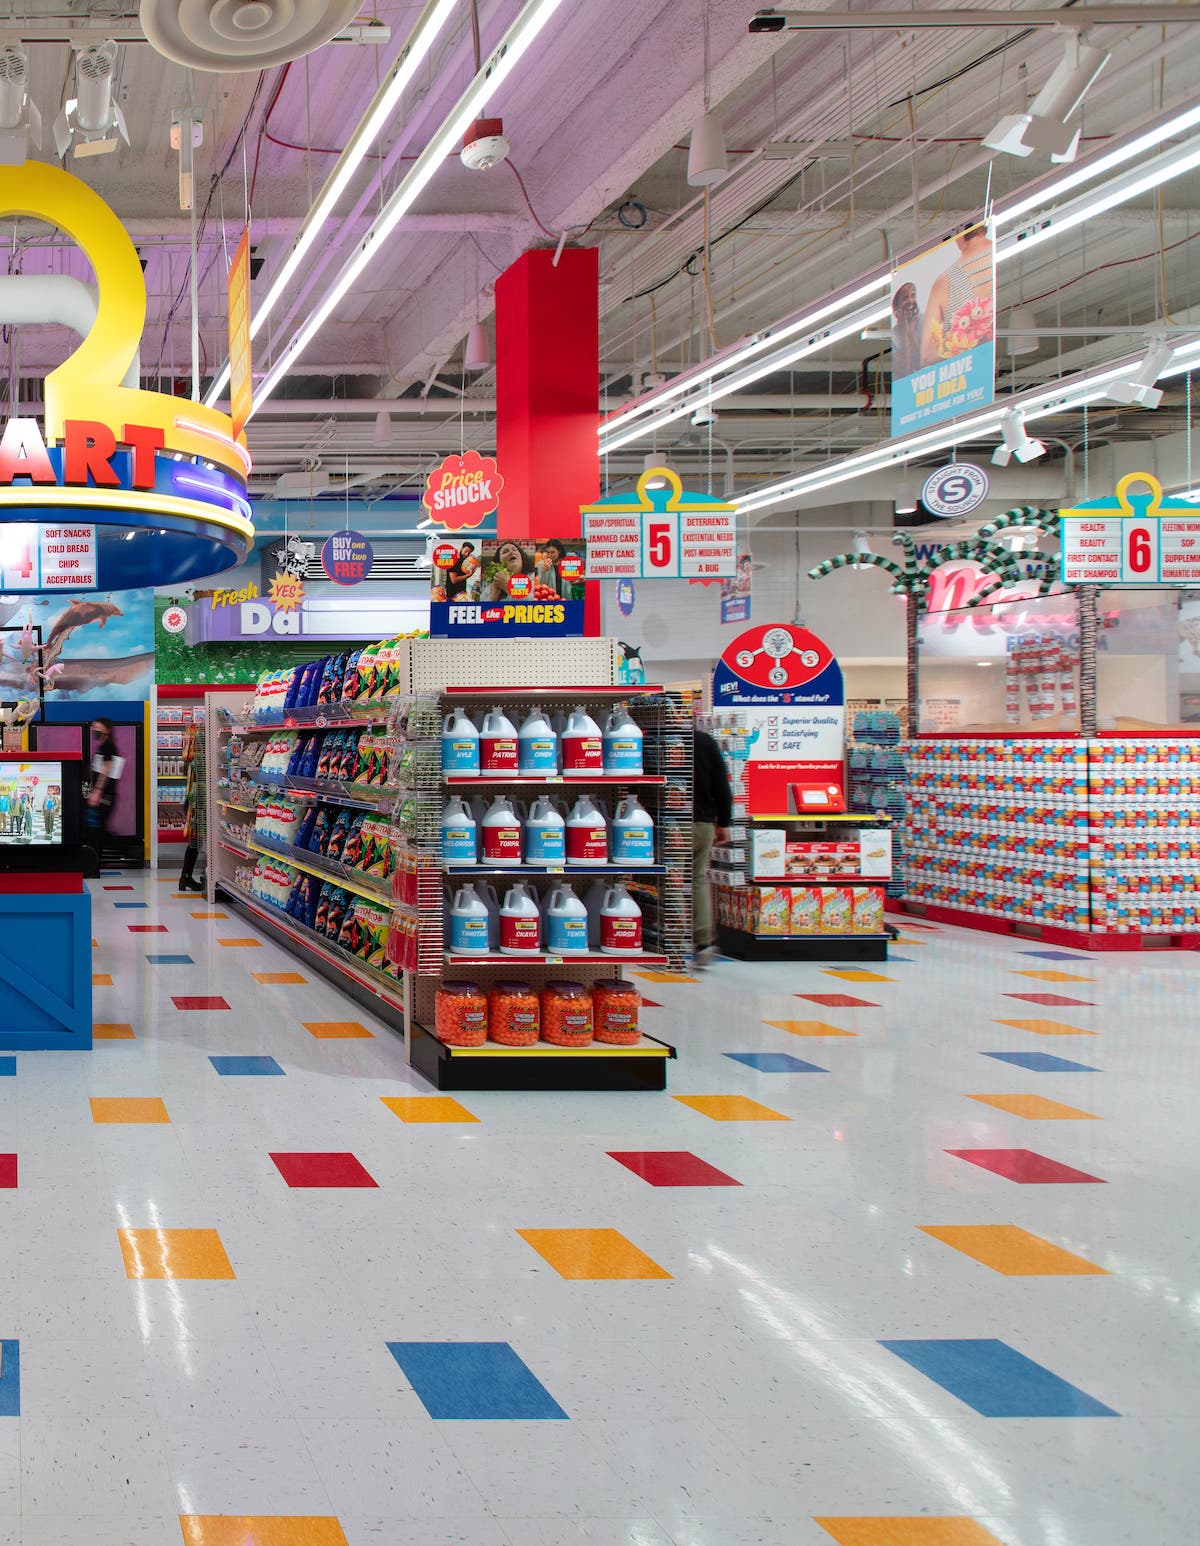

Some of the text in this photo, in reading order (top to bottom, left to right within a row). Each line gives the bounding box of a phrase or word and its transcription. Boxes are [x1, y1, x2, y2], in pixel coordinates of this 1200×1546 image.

[911, 354, 973, 393] YOU HAVE
[916, 374, 967, 407] NO IDEA
[440, 469, 484, 491] Price
[433, 480, 492, 510] SHOCK
[943, 479, 967, 502] S
[687, 517, 729, 526] DETERRENTS
[1081, 524, 1105, 532] HEALTH
[46, 530, 91, 538] SOFT SNACKS
[588, 534, 639, 543] JAMMED CANS
[332, 537, 351, 549] BUY
[649, 524, 671, 567] 5
[1080, 539, 1105, 547] BEAUTY
[1181, 539, 1195, 547] SOP
[48, 545, 89, 553] COLD BREAD
[1129, 528, 1151, 572] 6
[332, 549, 367, 561] BUY two
[591, 550, 635, 559] EMPTY CANS
[9, 543, 32, 578] 4
[59, 560, 79, 568] CHIPS
[334, 562, 364, 578] FREE
[591, 565, 613, 573] CANNED
[705, 564, 719, 572] BUG
[1067, 570, 1117, 578] DIET SHAMPOO
[46, 576, 92, 584] ACCEPTABLES
[211, 581, 258, 611] Fresh
[276, 585, 296, 598] YES
[448, 605, 565, 624] FEEL the PRICES
[720, 681, 738, 694] HEY!
[733, 695, 751, 703] What
[752, 695, 766, 703] does
[767, 695, 779, 703] the
[795, 695, 814, 703] stand
[782, 716, 838, 725] Superior Quality
[782, 729, 819, 738] Satisfying
[782, 742, 802, 750] SAFE
